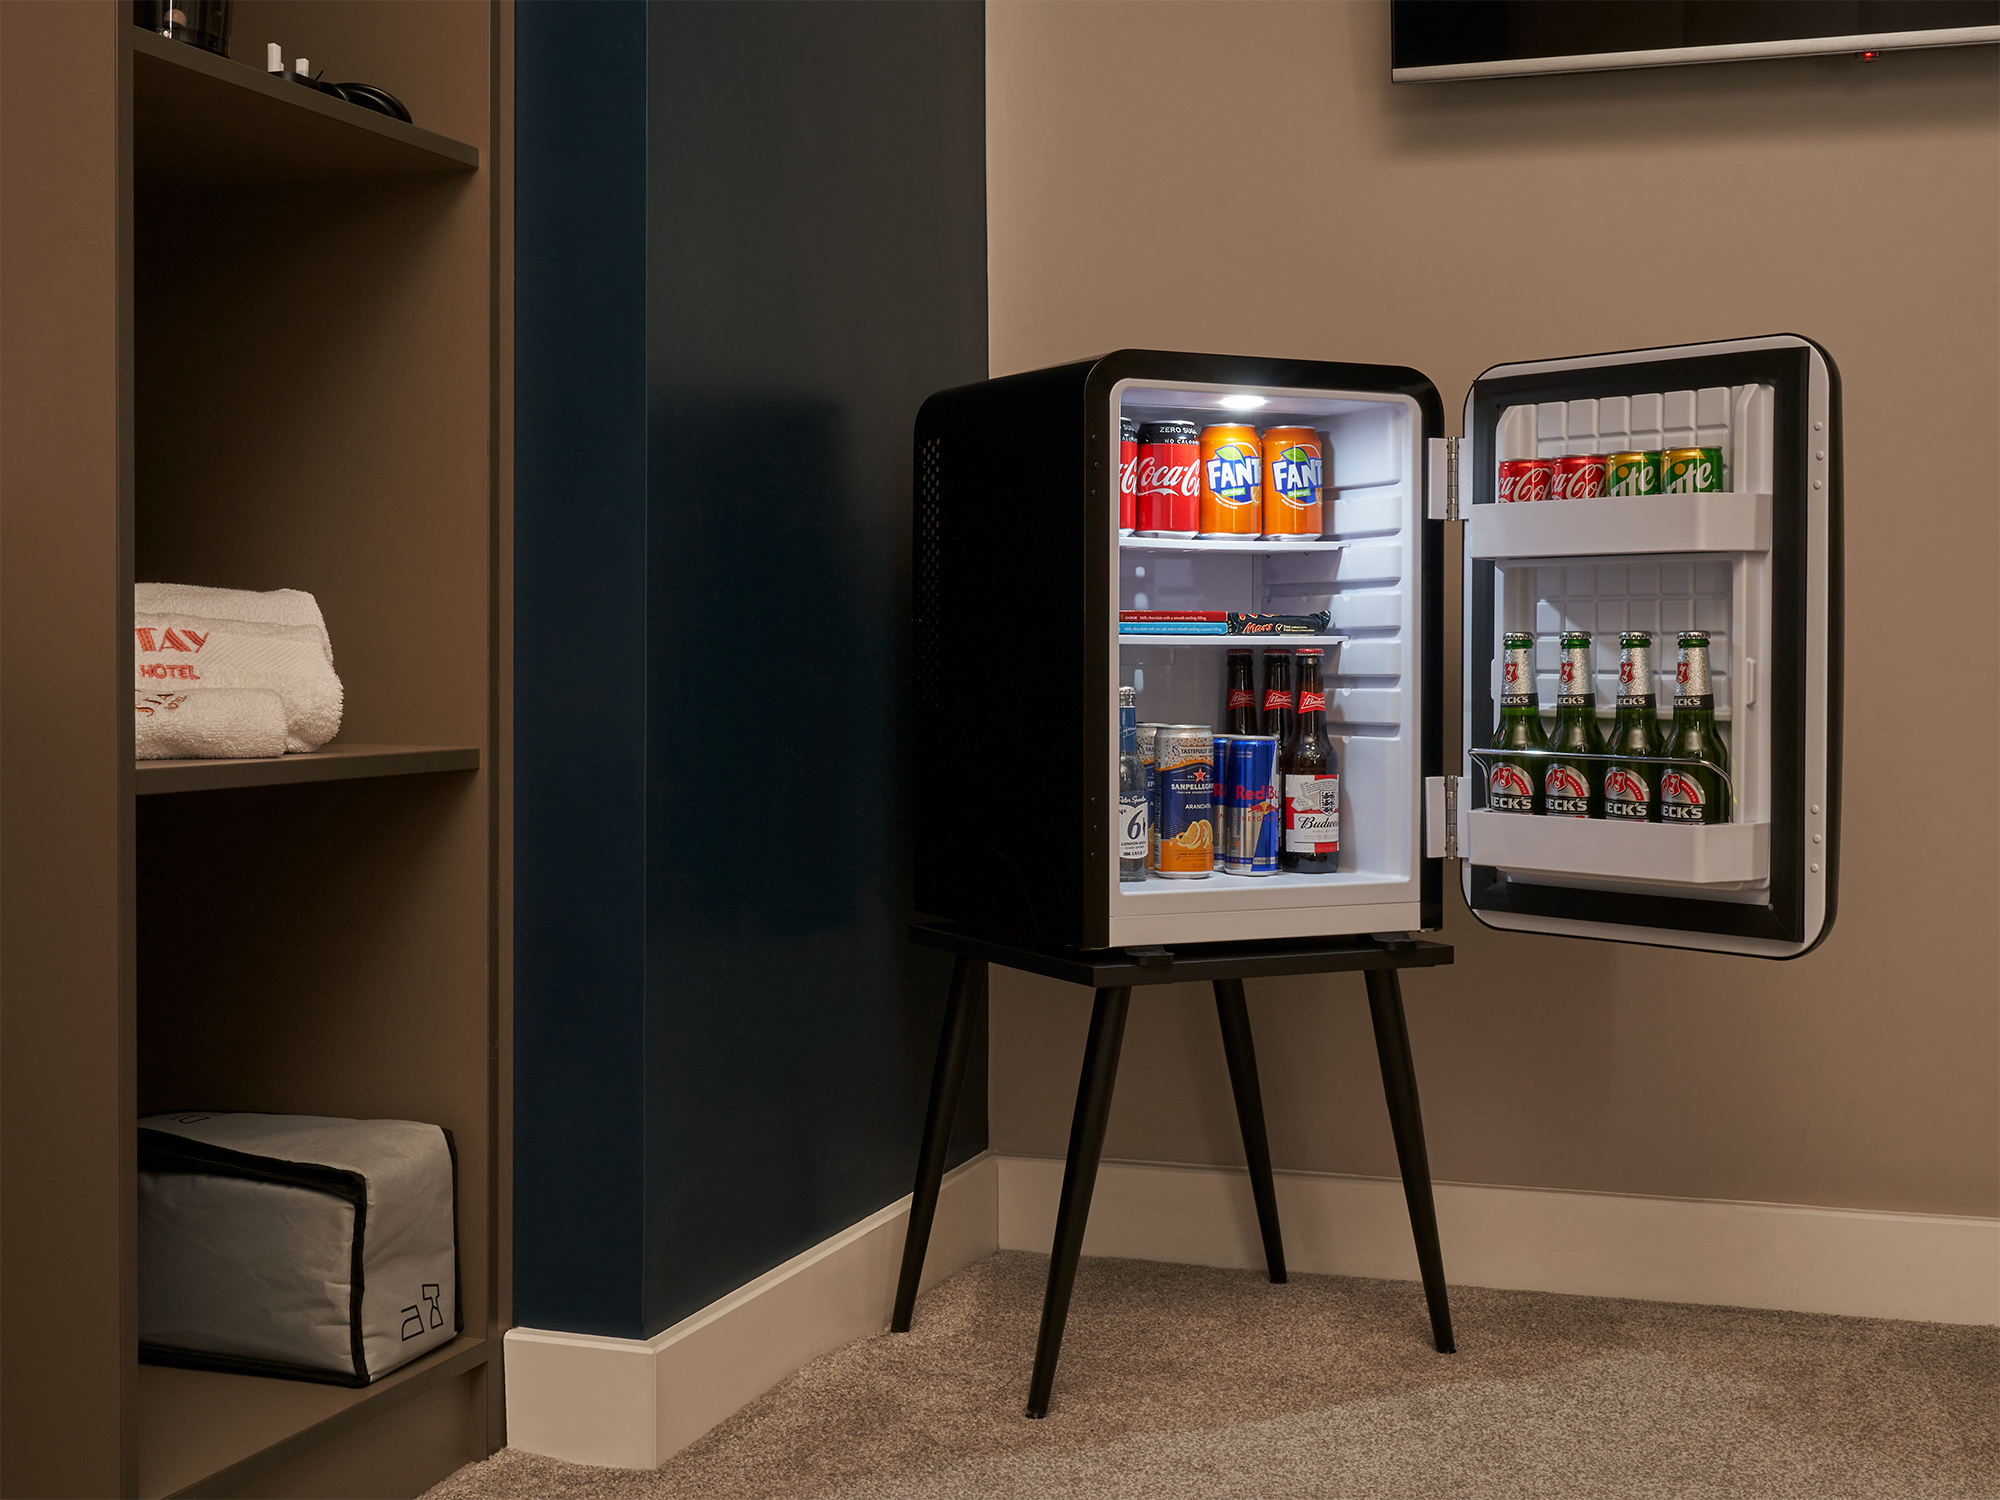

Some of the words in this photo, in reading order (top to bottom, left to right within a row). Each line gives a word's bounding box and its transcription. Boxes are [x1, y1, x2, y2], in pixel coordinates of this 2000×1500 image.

[1159, 426, 1182, 434] ZERO
[1609, 465, 1655, 497] rite
[1666, 462, 1713, 494] rite
[1242, 622, 1273, 634] Mars
[135, 627, 209, 654] TAY
[140, 663, 201, 680] HOTEL
[1501, 695, 1529, 705] ECK'S
[1558, 695, 1585, 705] ECK'S
[1618, 695, 1646, 706] ECK'S
[1675, 696, 1701, 706] ECK'S
[1235, 784, 1265, 800] Red
[1127, 809, 1143, 839] 6
